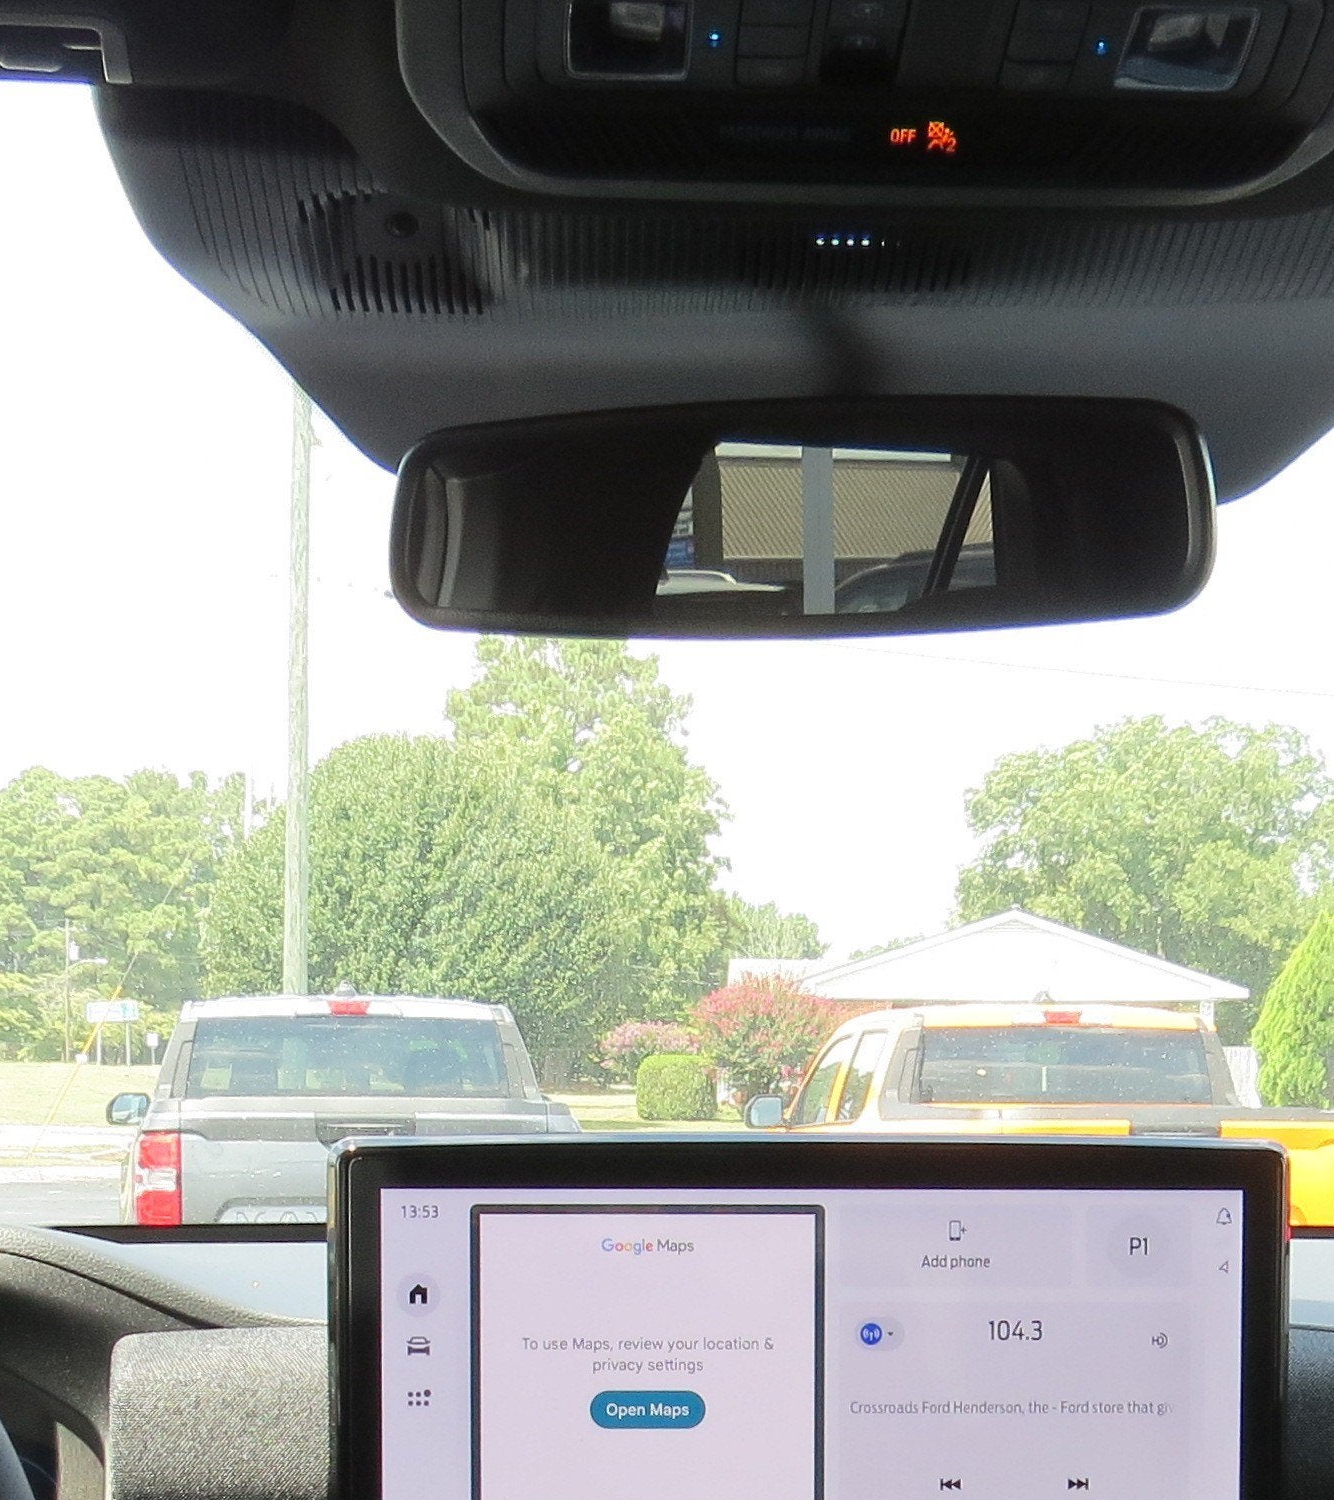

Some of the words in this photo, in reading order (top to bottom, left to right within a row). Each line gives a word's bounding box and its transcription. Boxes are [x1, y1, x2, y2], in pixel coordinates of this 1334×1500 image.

[890, 128, 917, 143] OFF
[401, 1205, 440, 1219] 13:53
[601, 1238, 654, 1255] Google
[656, 1239, 694, 1254] Maps
[1128, 1236, 1149, 1256] P1
[921, 1255, 948, 1269] Add
[949, 1255, 991, 1271] phone
[987, 1320, 1044, 1342] 104.3
[522, 1337, 539, 1351] To
[542, 1340, 568, 1351] use
[572, 1337, 614, 1353] Maps,
[617, 1337, 664, 1351] review
[666, 1340, 699, 1354] your
[702, 1336, 760, 1351] location
[764, 1337, 775, 1351] &
[592, 1358, 643, 1375] privacy
[647, 1357, 704, 1375] settings
[605, 1402, 646, 1420] Open
[649, 1402, 690, 1420] Maps
[849, 1400, 919, 1415] Crossroads
[921, 1400, 951, 1415] Ford
[953, 1400, 1025, 1417] Henderson,
[1028, 1400, 1049, 1415] the
[1060, 1400, 1089, 1415] Ford
[1091, 1402, 1124, 1415] store
[1126, 1400, 1155, 1415] that
